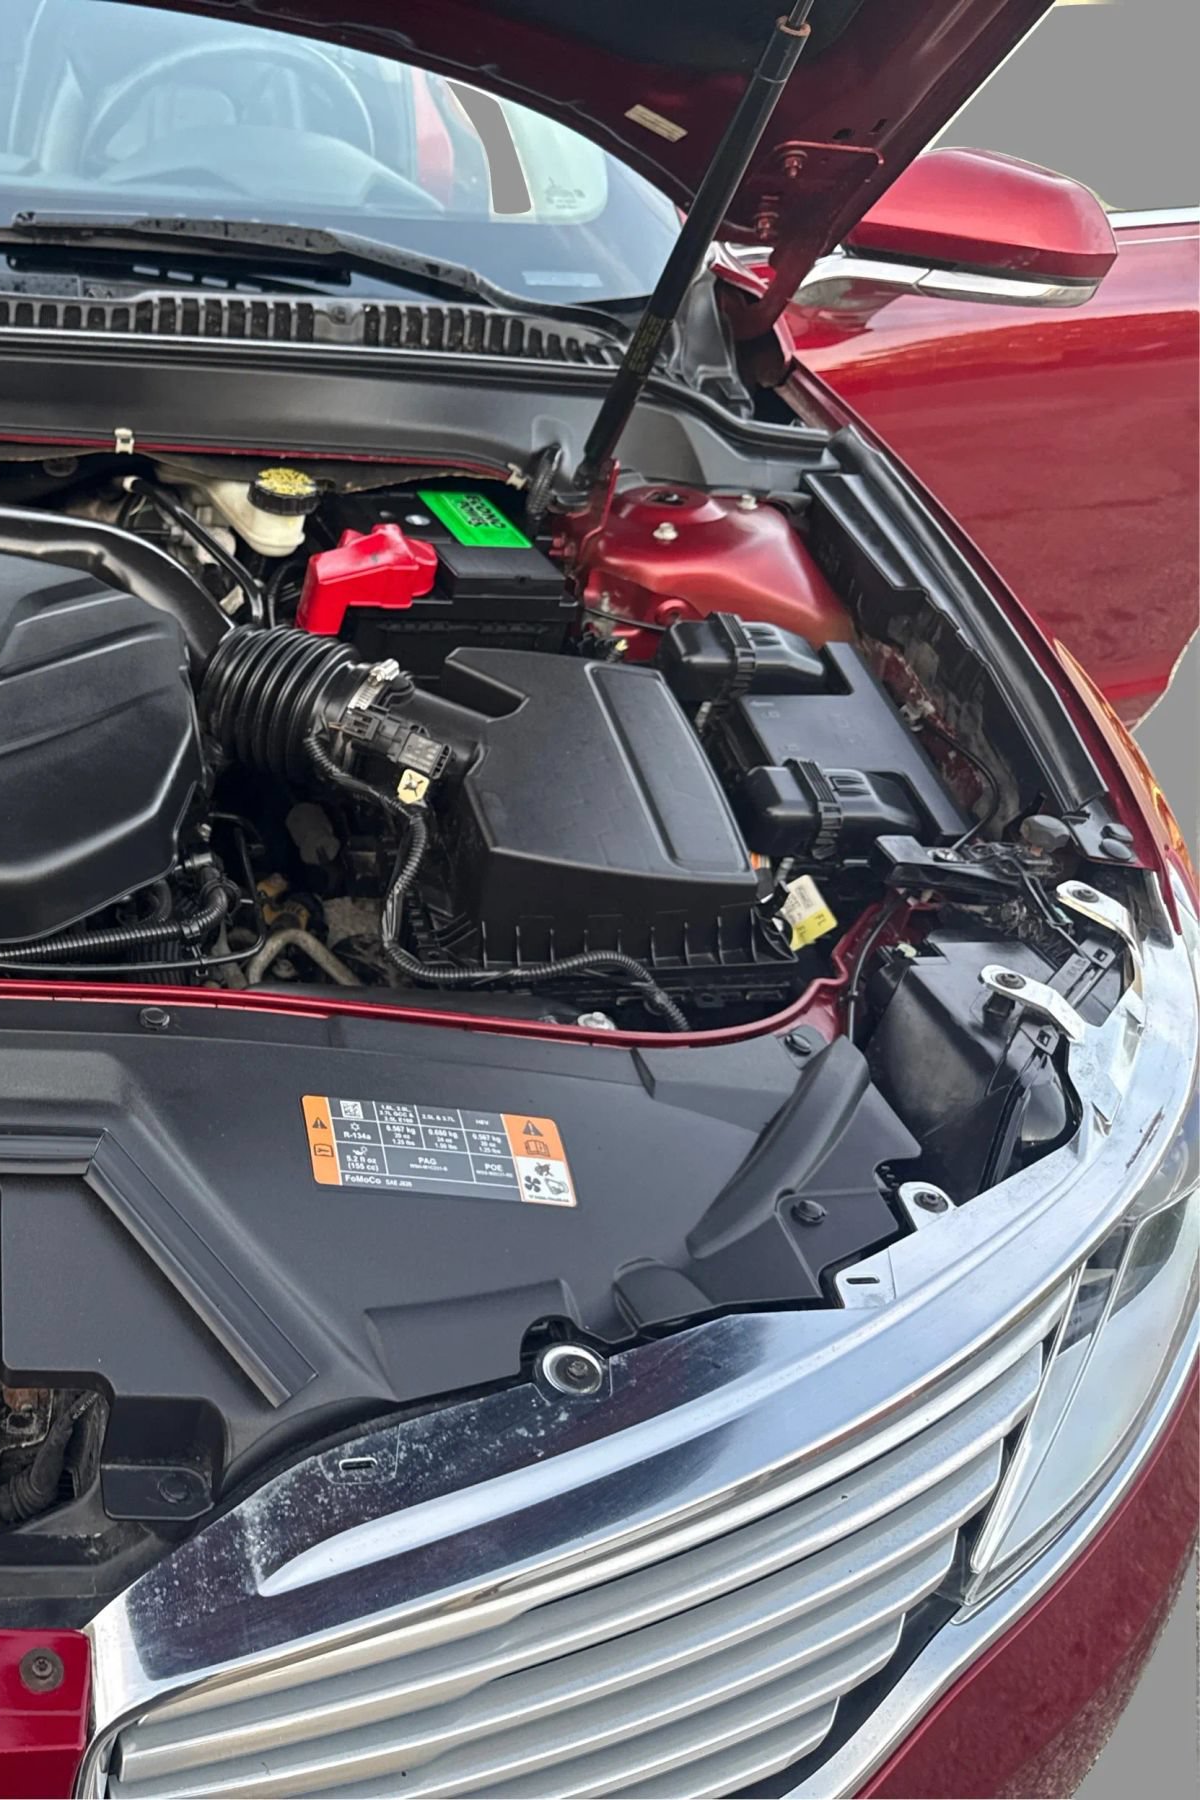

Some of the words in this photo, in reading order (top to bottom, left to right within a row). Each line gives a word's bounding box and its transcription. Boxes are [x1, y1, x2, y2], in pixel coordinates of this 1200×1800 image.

[406, 1126, 416, 1135] kg
[448, 1130, 459, 1140] kg
[343, 1131, 371, 1140] R-134a
[491, 1134, 502, 1144] kg
[418, 1156, 437, 1165] PAG
[347, 1162, 365, 1170] (155
[366, 1163, 379, 1172] cc)
[484, 1163, 503, 1172] POE
[344, 1174, 382, 1185] FoMoCo
